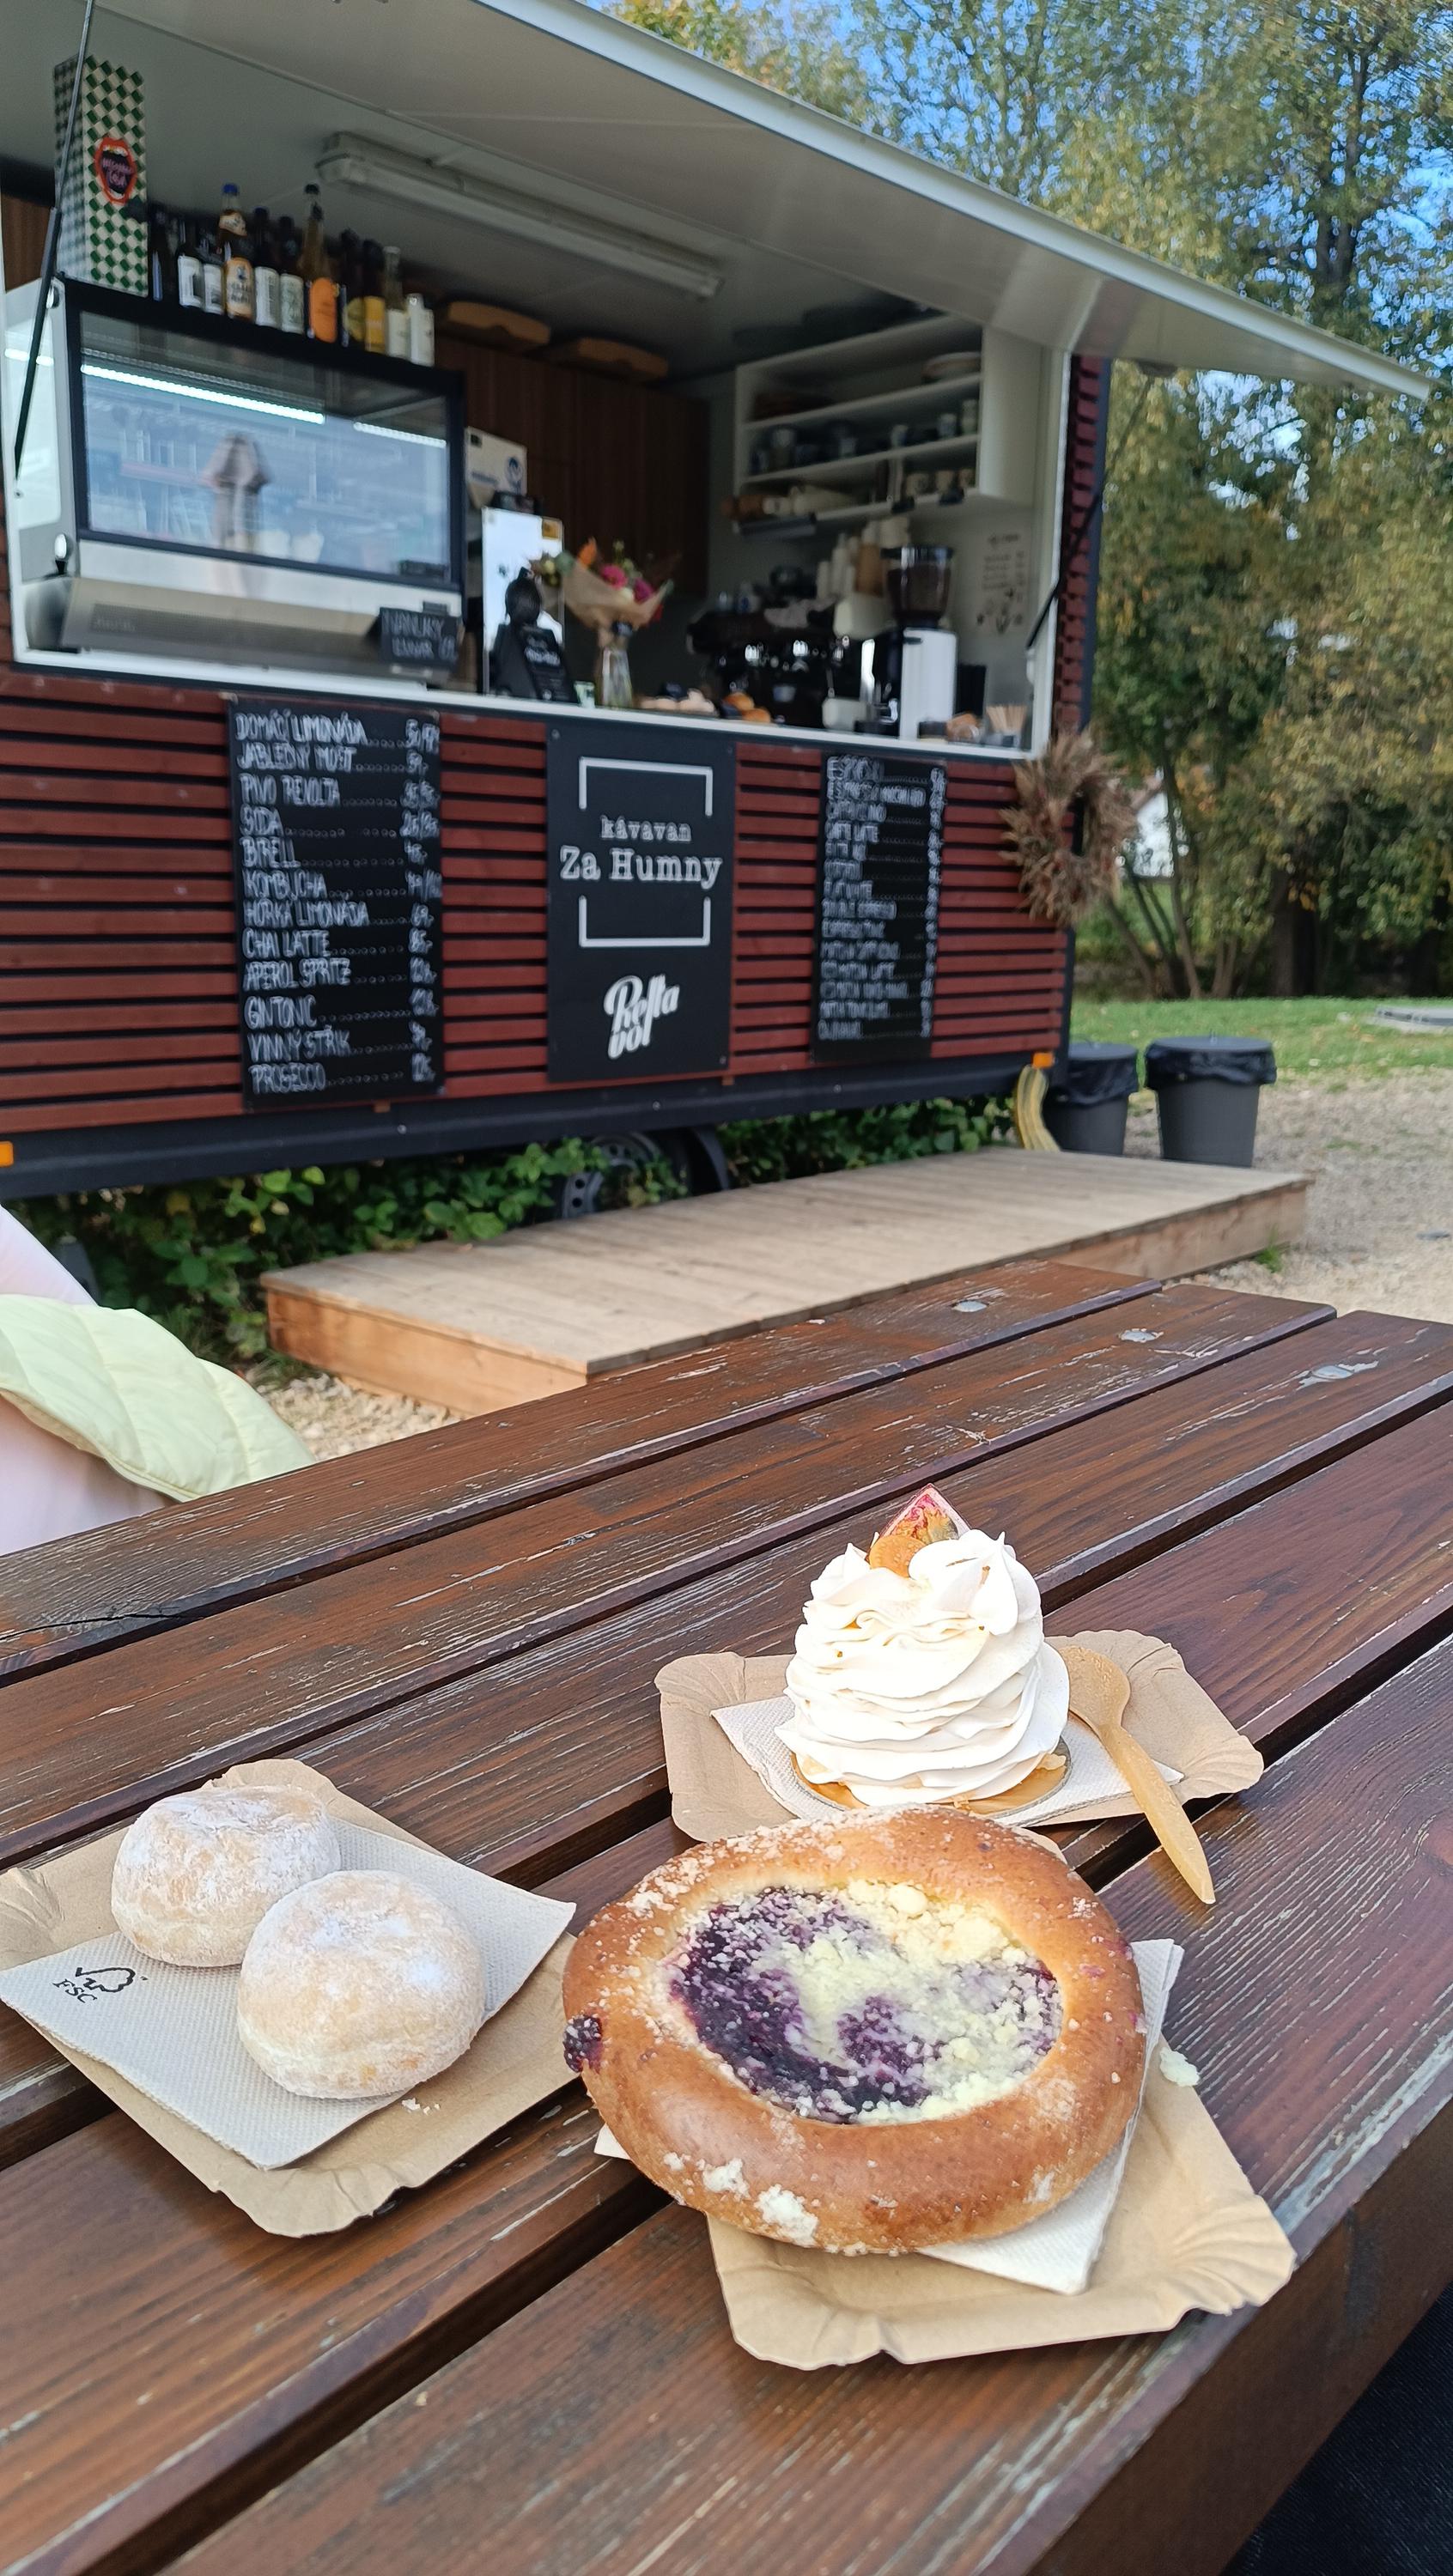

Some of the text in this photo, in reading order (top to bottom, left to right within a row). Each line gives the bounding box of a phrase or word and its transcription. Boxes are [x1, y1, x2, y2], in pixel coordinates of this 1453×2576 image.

[600, 816, 692, 843] kávavan
[560, 845, 723, 890] Za Humny
[282, 928, 331, 957] LATTE
[52, 1978, 97, 2003] FSC
